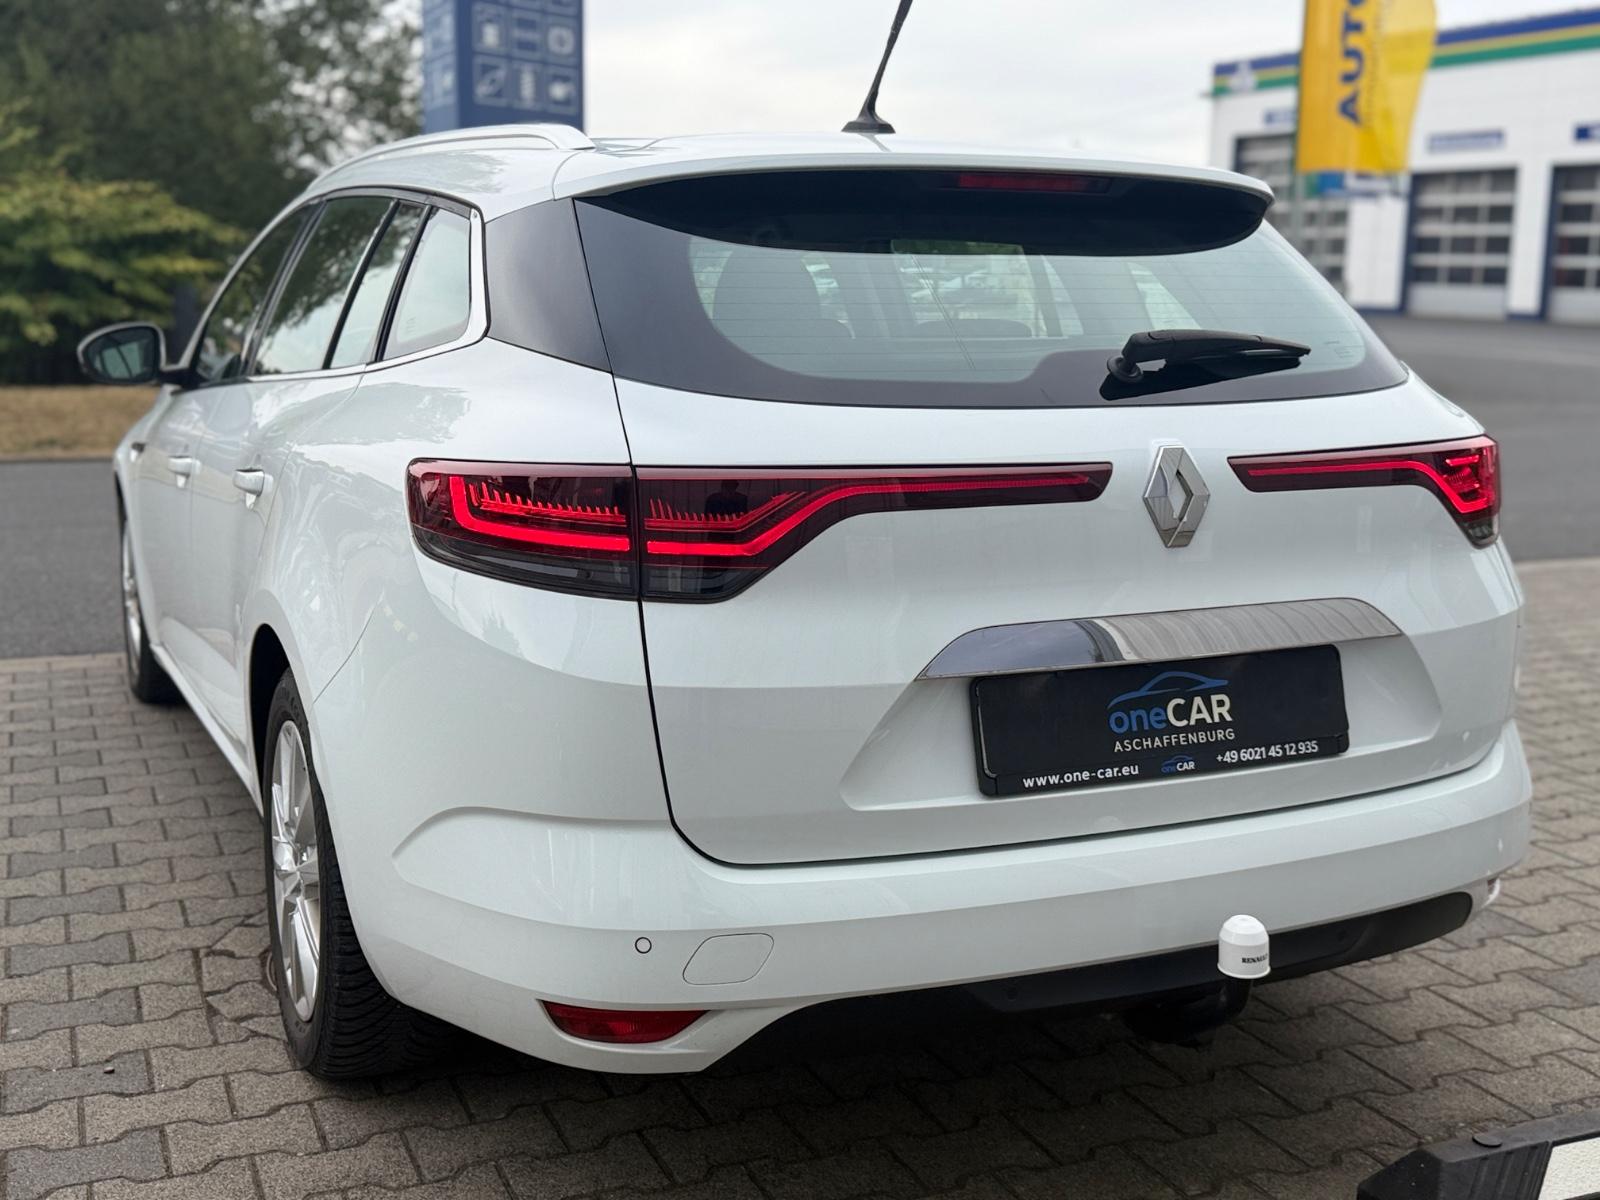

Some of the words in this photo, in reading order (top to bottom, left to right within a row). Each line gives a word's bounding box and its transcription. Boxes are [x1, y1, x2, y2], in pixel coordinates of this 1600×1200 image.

[1339, 0, 1364, 127] AUT
[1109, 694, 1233, 734] oneCAR
[1114, 728, 1236, 753] ASCHAFFENBURG
[1216, 750, 1238, 763] +49
[1240, 747, 1266, 761] 6021
[1268, 744, 1283, 757] 45
[1284, 743, 1297, 756] 12
[1298, 740, 1318, 754] 935
[1023, 764, 1139, 788] www.one-car.eu
